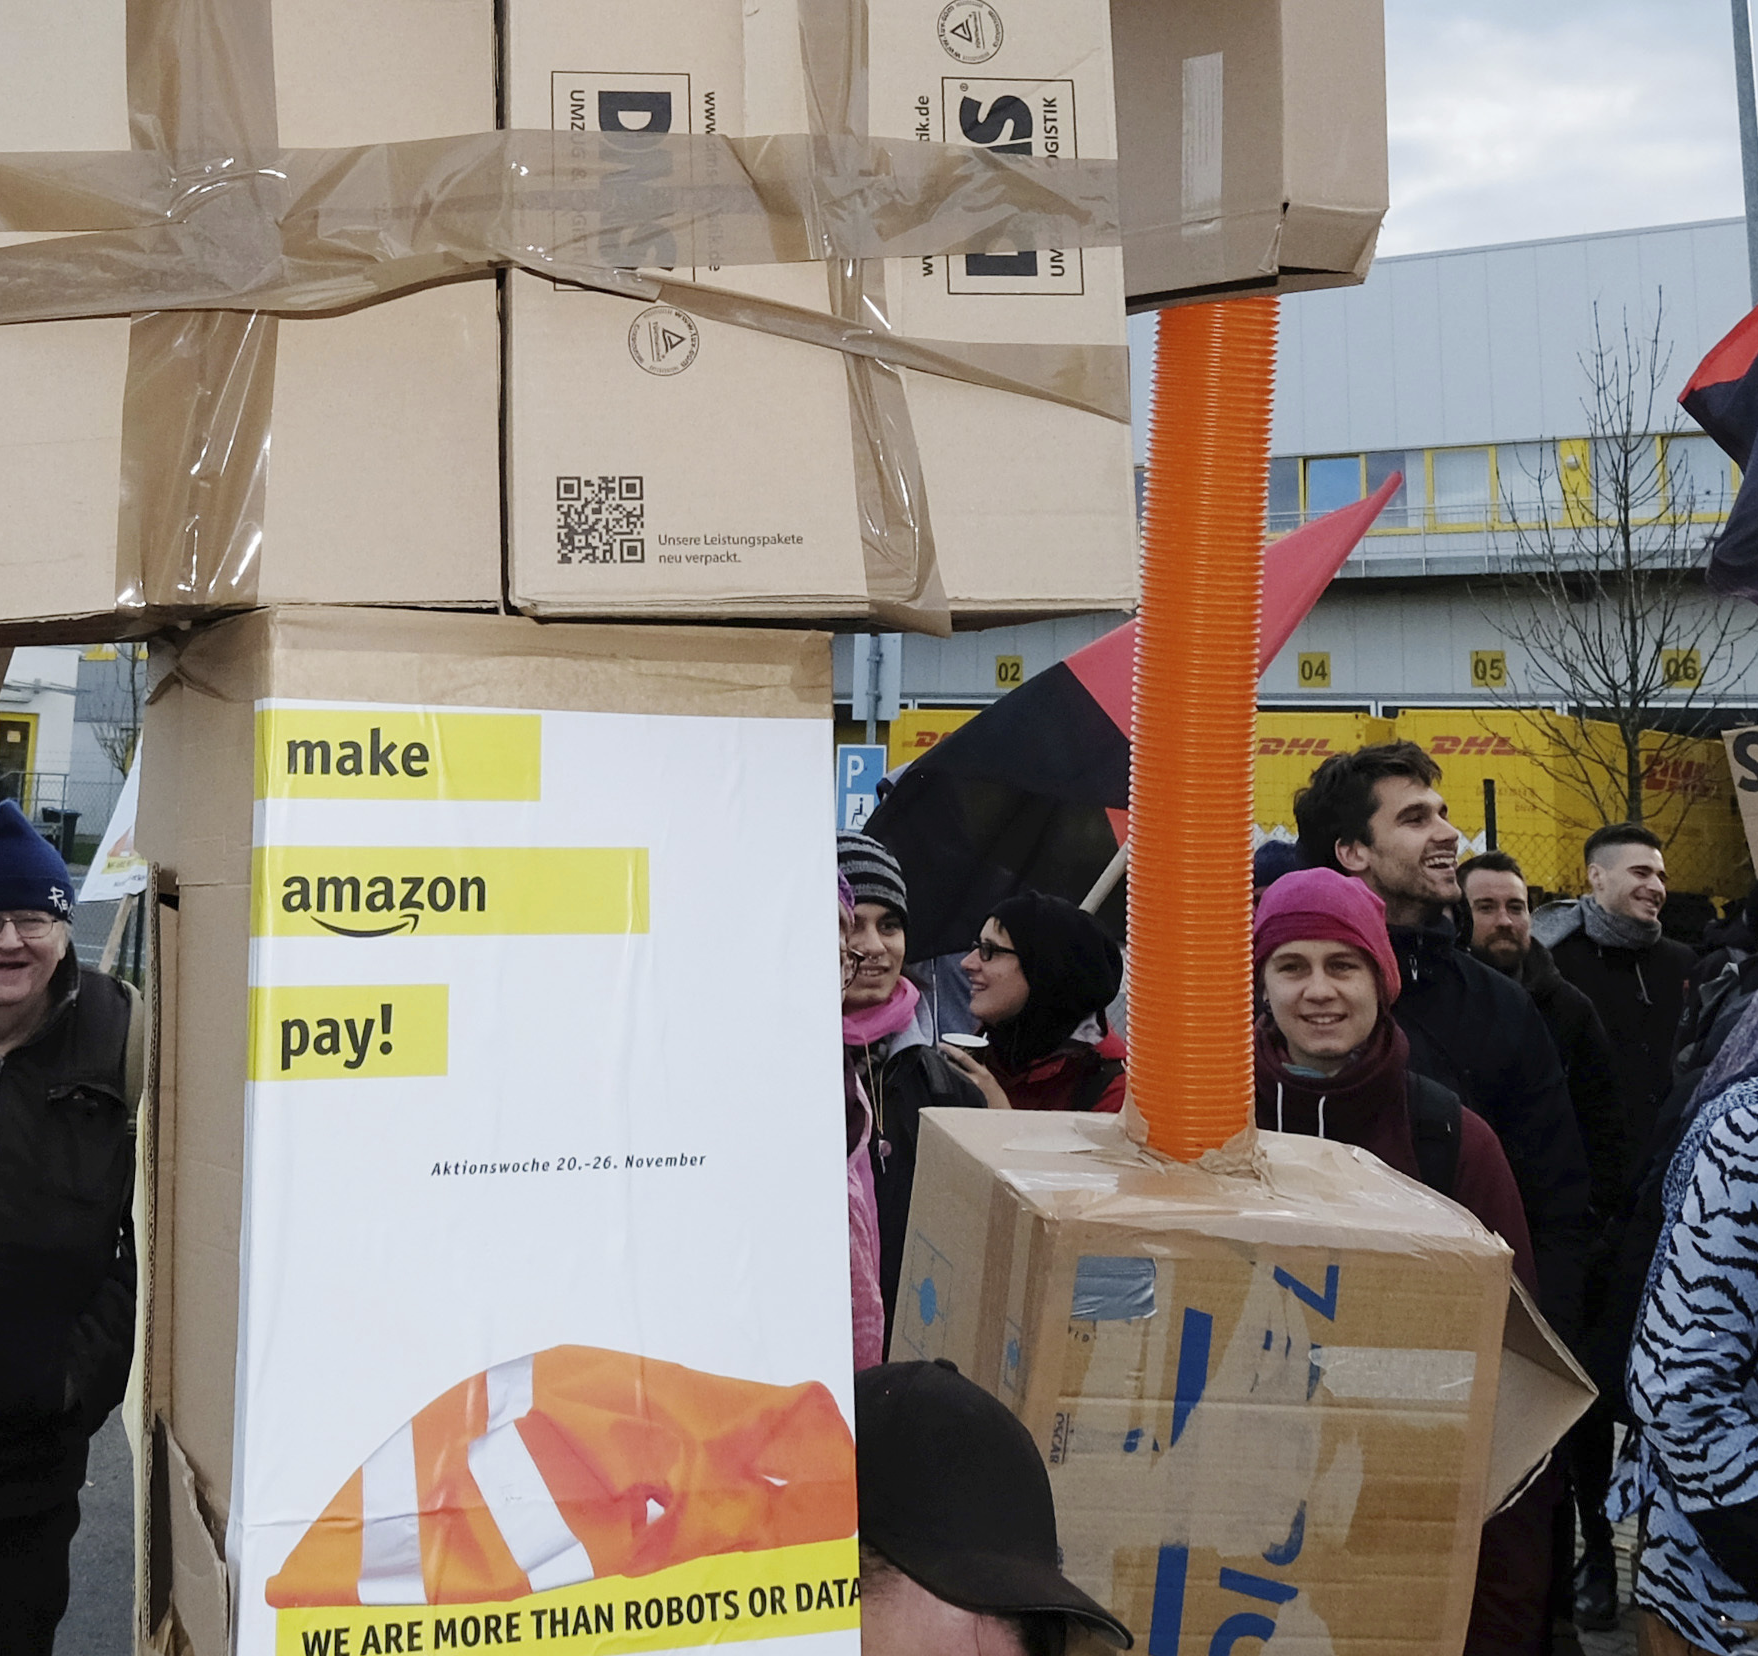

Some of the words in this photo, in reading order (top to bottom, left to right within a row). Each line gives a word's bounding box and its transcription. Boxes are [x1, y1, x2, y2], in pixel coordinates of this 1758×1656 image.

[657, 533, 701, 546] Unsere
[703, 532, 804, 548] Leistungspakete
[658, 553, 682, 564] neu
[684, 550, 742, 566] verpackt.
[997, 662, 1021, 682] 02
[1300, 659, 1328, 682] 04
[1472, 657, 1504, 682] 05
[1666, 657, 1698, 682] 06
[286, 726, 430, 778] make
[1257, 737, 1336, 757] DHL
[1429, 735, 1518, 756] DHL
[845, 754, 865, 789] P
[281, 875, 486, 913] amazon
[280, 1002, 393, 1072] pay!
[431, 1157, 551, 1177] Aktionswoche
[556, 1155, 619, 1172] 20.-26.
[624, 1152, 707, 1169] November
[301, 1626, 351, 1656] WE
[359, 1619, 424, 1655] ARE
[433, 1610, 522, 1650] MORE
[530, 1602, 614, 1640] THAN
[624, 1589, 740, 1632] ROBOTS
[748, 1585, 788, 1619] OR
[795, 1577, 861, 1613] DATA
